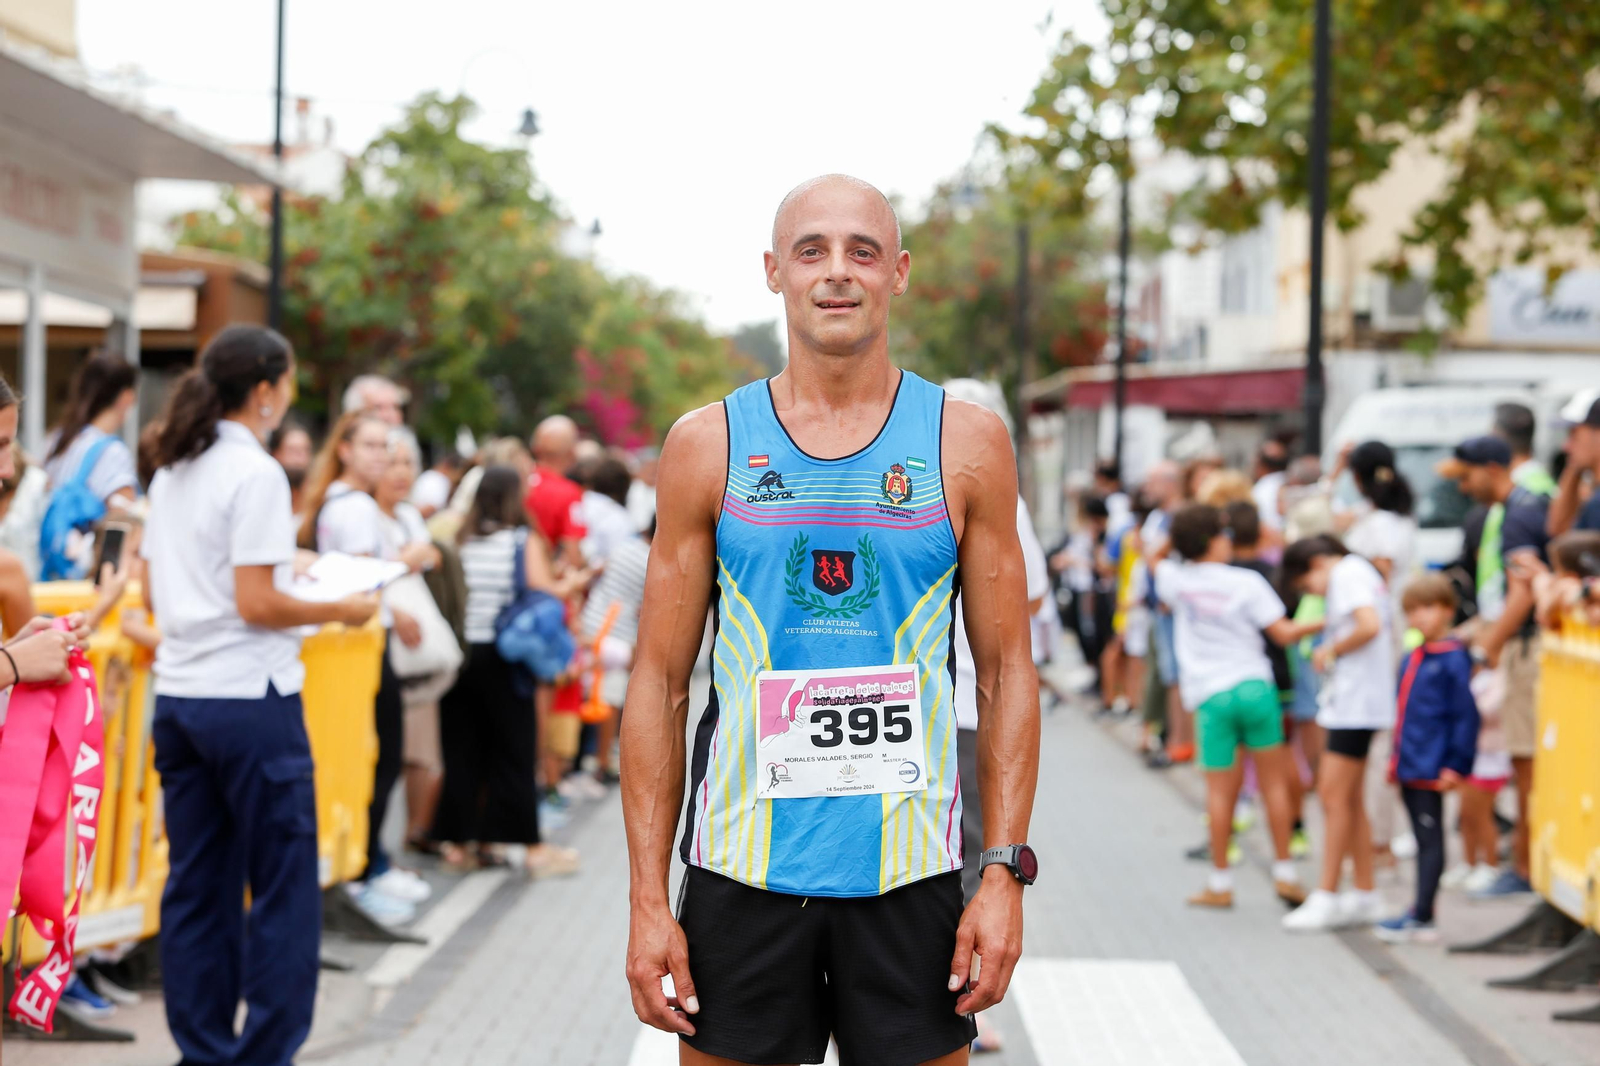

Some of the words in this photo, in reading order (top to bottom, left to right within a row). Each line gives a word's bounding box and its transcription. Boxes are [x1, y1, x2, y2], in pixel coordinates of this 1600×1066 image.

[875, 501, 916, 515] Ayuntamiento
[886, 509, 912, 519] Algeciras
[825, 619, 860, 628] ATLETAS
[833, 628, 878, 637] ALGECIRAS
[881, 681, 913, 694] valores
[810, 704, 913, 748] 395
